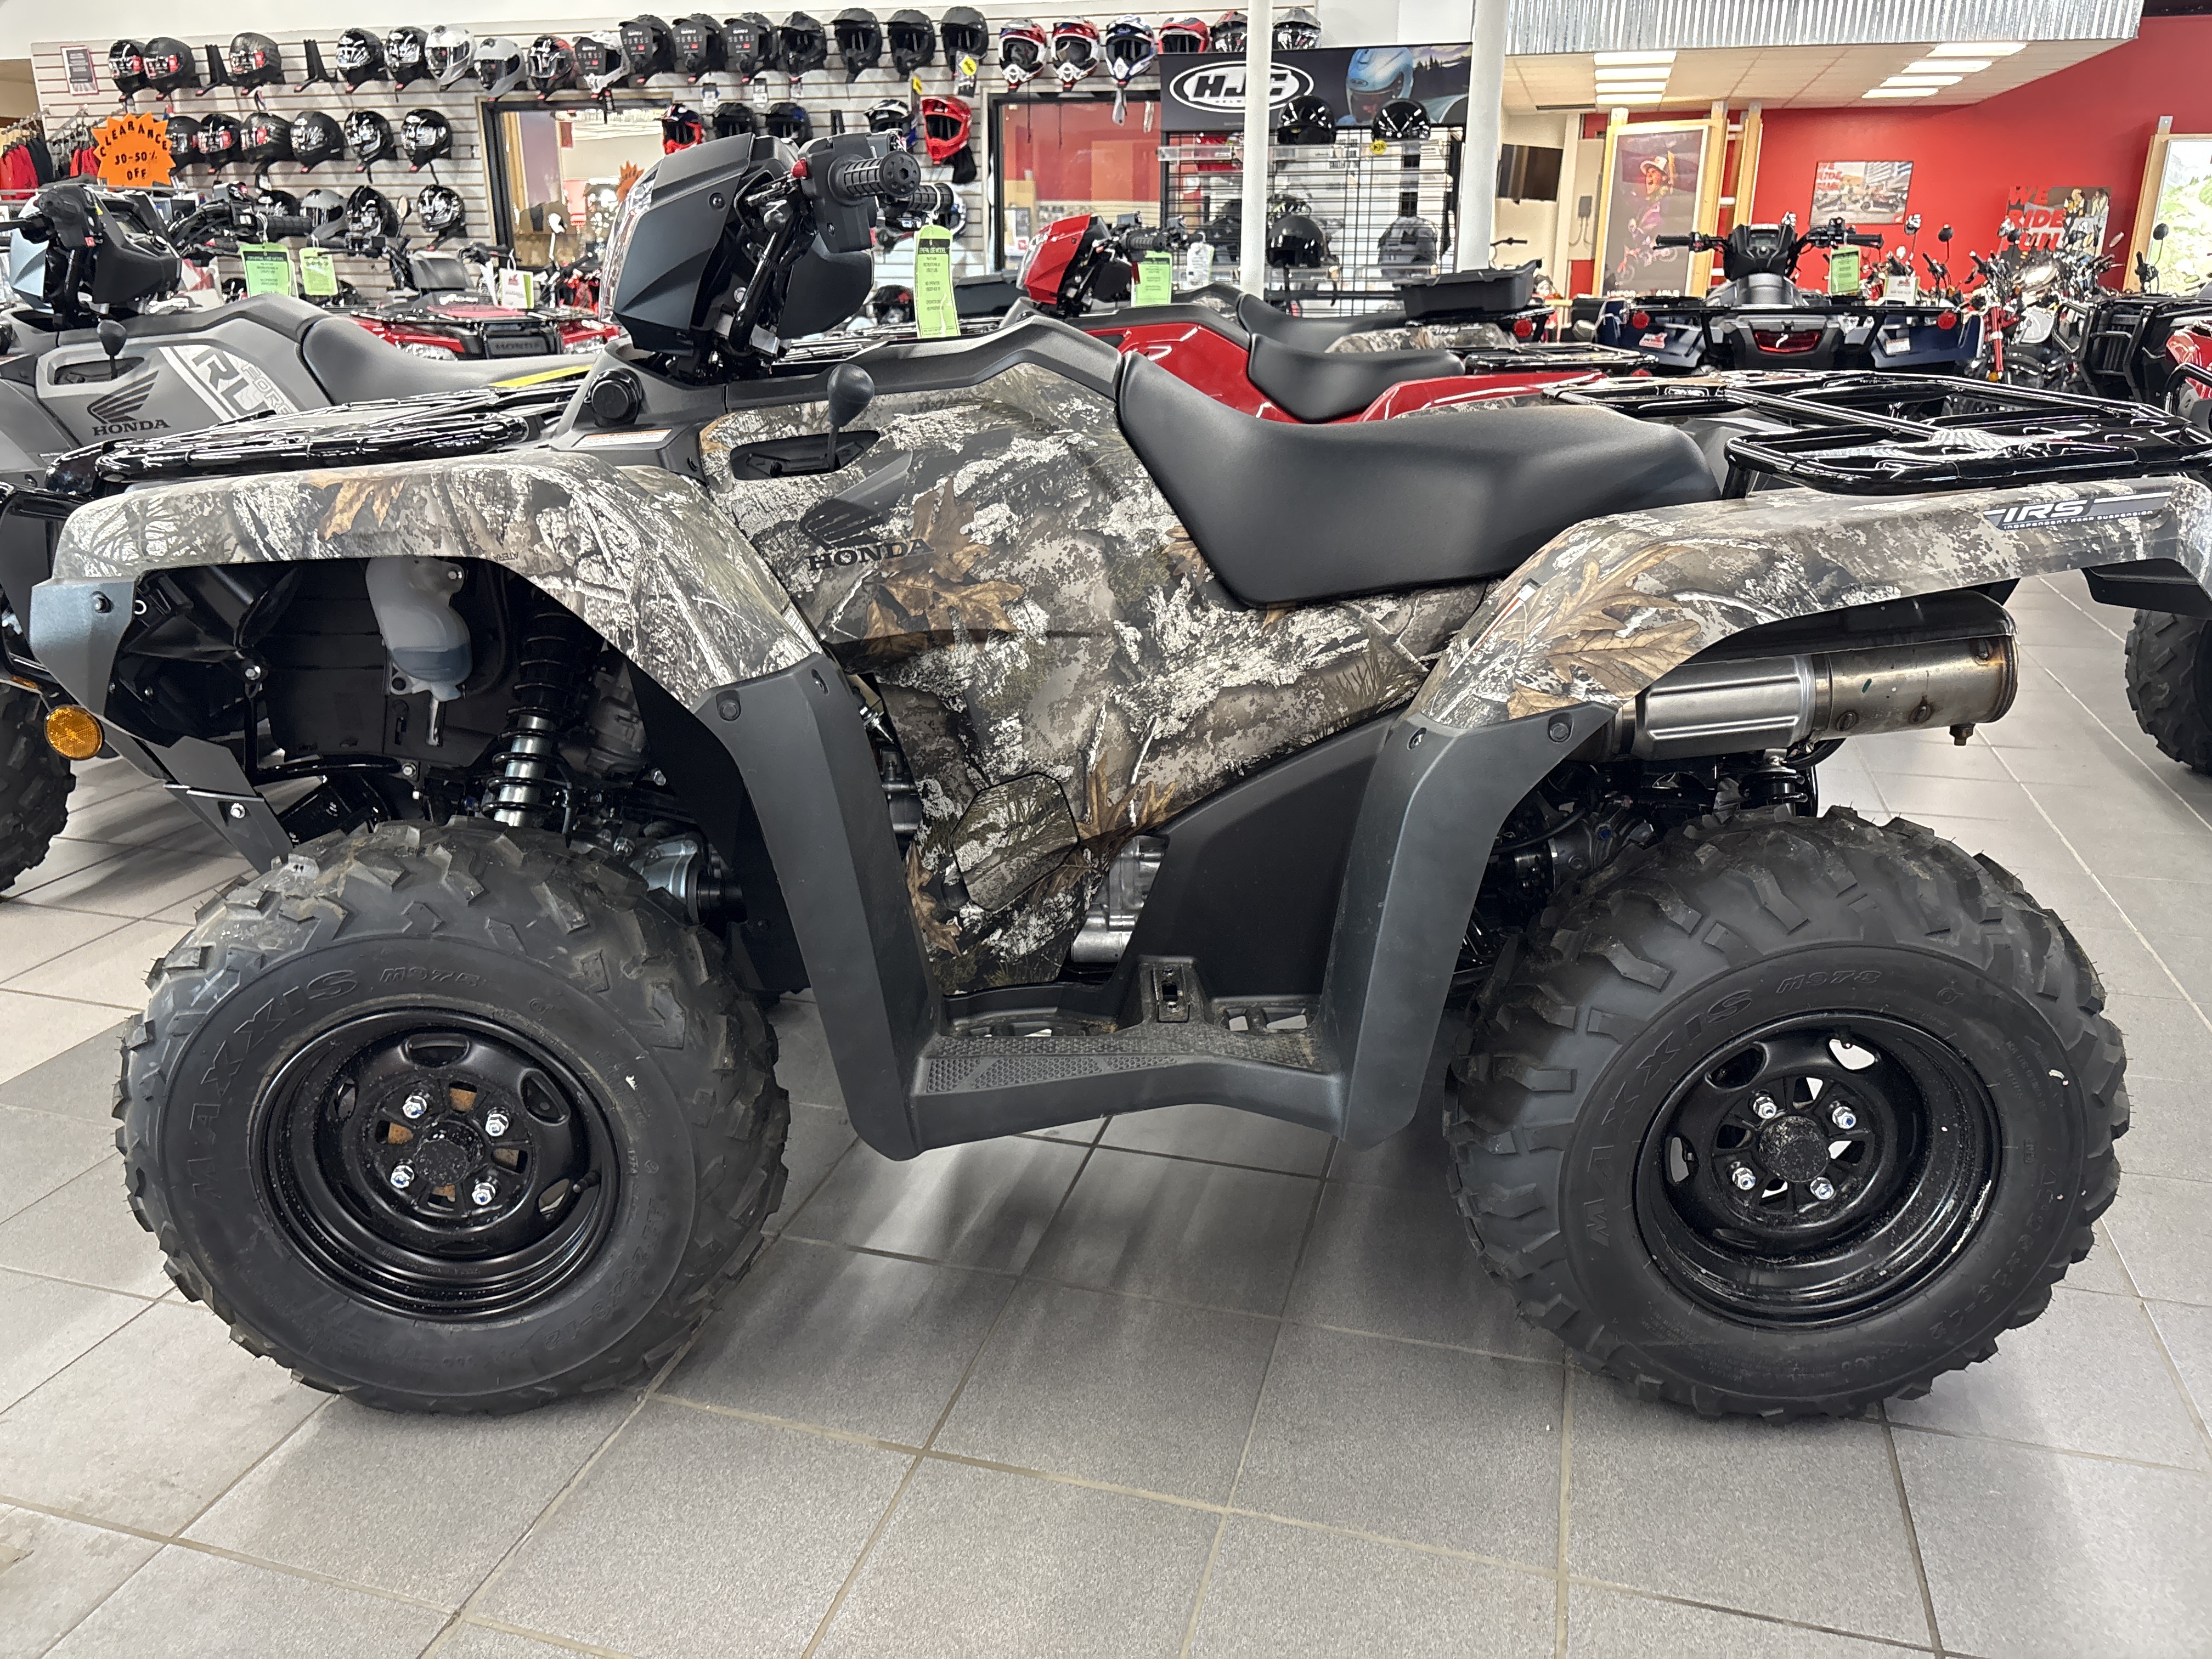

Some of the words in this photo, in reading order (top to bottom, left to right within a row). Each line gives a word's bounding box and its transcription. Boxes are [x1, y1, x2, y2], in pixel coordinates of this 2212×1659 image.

[100, 121, 168, 157] CLEARANCE
[126, 167, 147, 181] OFF
[2008, 210, 2066, 229] RIDE
[92, 419, 171, 436] HONDA
[2003, 499, 2088, 523] IRS
[2004, 519, 2068, 529] INDEPENDENT
[2097, 510, 2153, 520] SUSPENSION
[806, 538, 936, 571] HONDA
[187, 969, 358, 1200] MAXXIS
[1583, 989, 1752, 1249] MAXXIS
